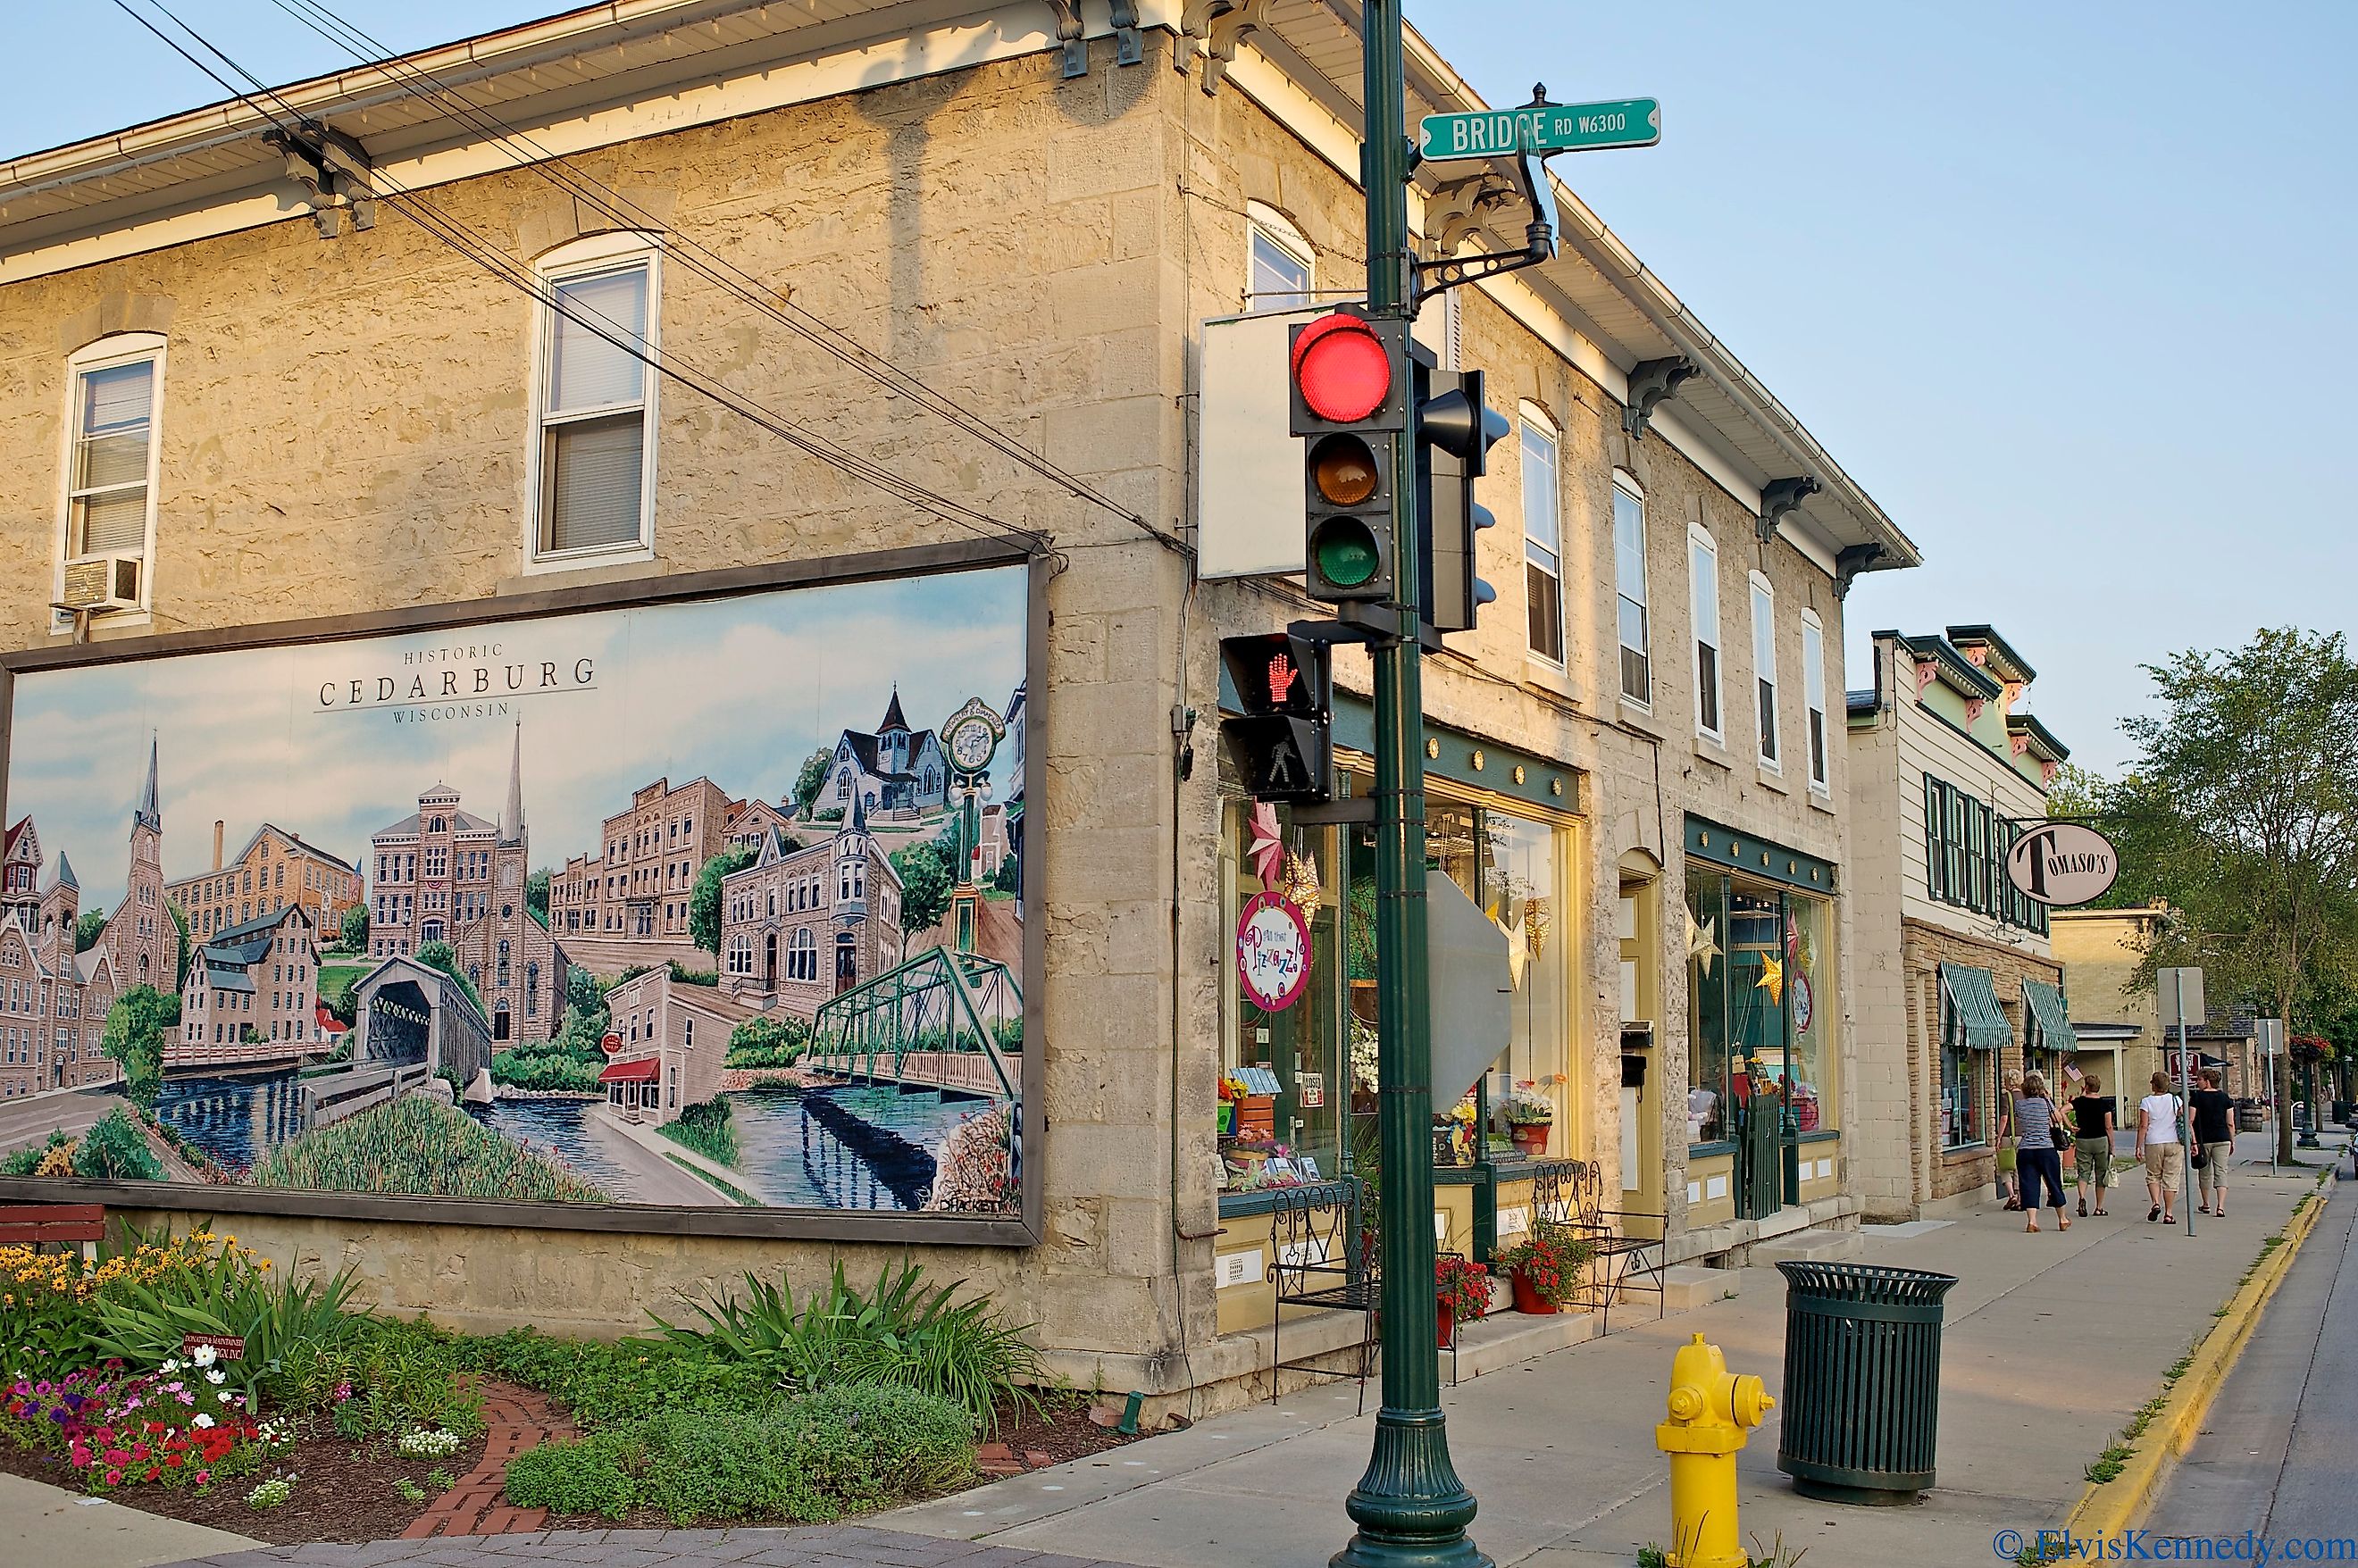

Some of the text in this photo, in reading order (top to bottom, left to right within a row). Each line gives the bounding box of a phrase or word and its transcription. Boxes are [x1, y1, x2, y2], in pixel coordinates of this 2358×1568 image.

[1452, 112, 1626, 152] BRIDGE RD W6300
[404, 643, 503, 665] HISTORIC
[319, 657, 595, 706] CEDARBURG
[393, 702, 508, 724] WISCONSIN
[2016, 830, 2108, 899] TOMASO'S
[185, 1335, 207, 1343] DONATED
